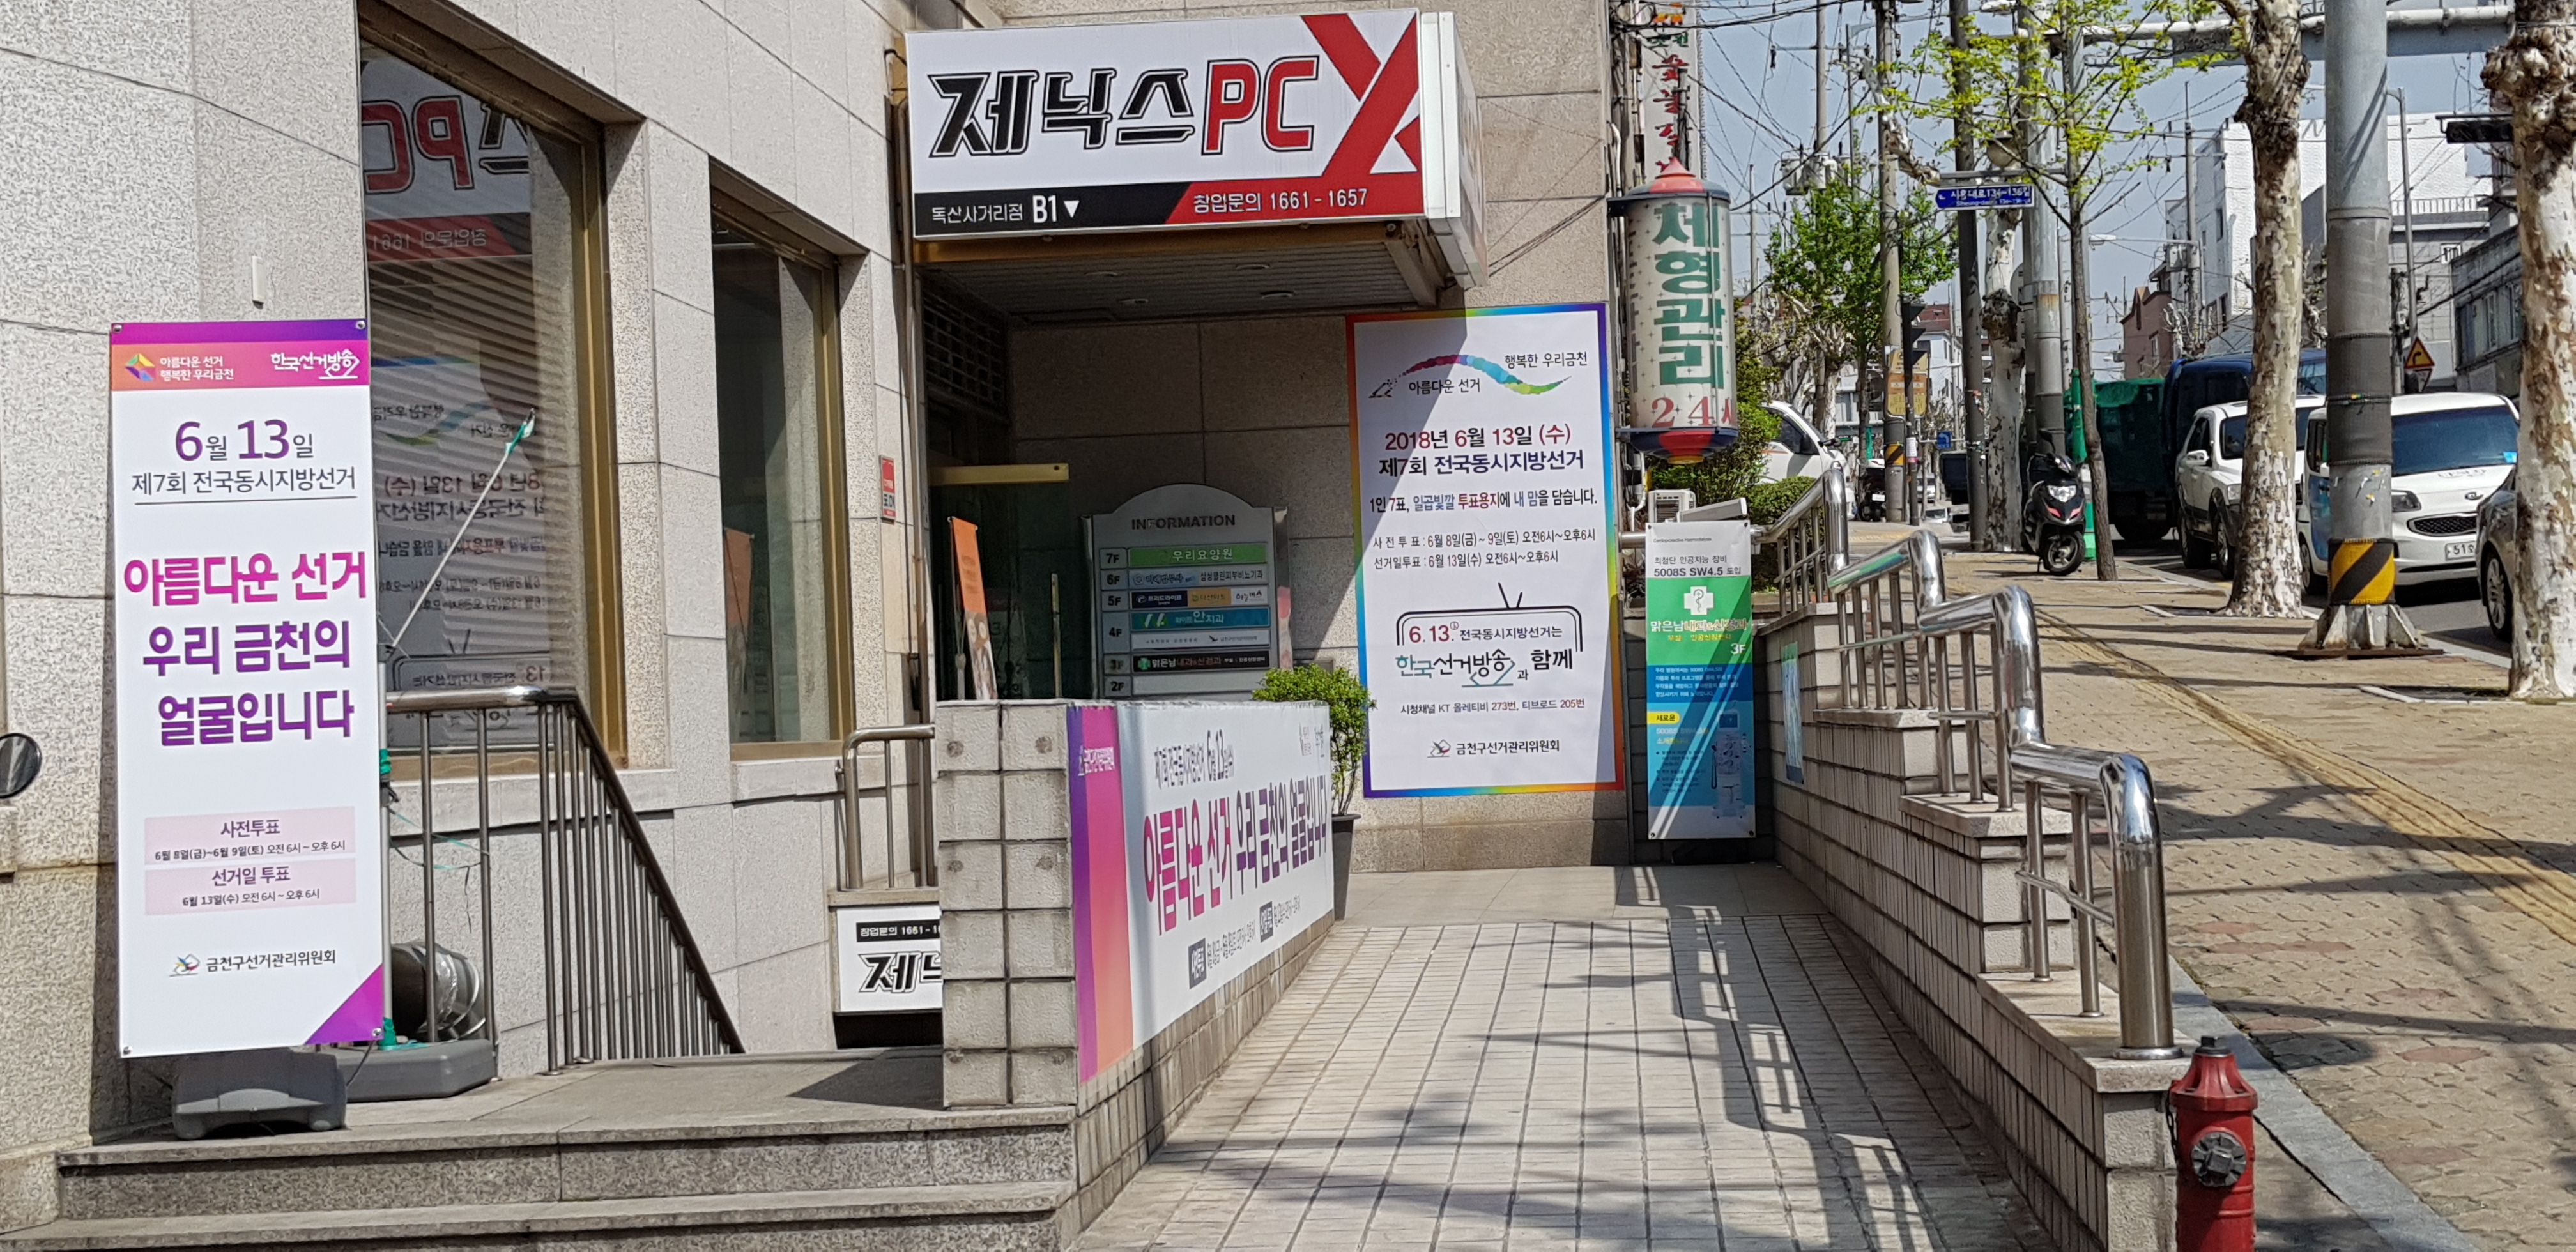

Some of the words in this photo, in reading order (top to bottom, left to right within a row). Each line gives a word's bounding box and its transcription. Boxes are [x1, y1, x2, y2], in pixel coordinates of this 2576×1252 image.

[931, 202, 1023, 225] 독산사거리점
[1032, 194, 1060, 224] B1
[1193, 191, 1262, 214] 창업문의
[1652, 203, 1725, 389] 체형관리
[160, 357, 200, 367] 아름다운
[203, 356, 223, 367] 선거
[271, 349, 360, 380] 한국선거방송
[1505, 353, 1538, 369] 행복한
[1542, 351, 1588, 367] 우리금천
[160, 369, 190, 381] 행복한
[193, 368, 234, 380] 우리금천
[1409, 379, 1455, 395] 아름다운
[1458, 378, 1481, 393] 선거
[175, 421, 228, 461] 6월
[237, 418, 314, 459] 13일
[1385, 429, 1448, 450] 2018년
[1455, 427, 1485, 447] 6월
[1492, 425, 1532, 446] 13일
[1539, 423, 1571, 445] (수)
[1379, 456, 1427, 477] 제7회
[1434, 449, 1584, 475] 전국동시지방선거
[132, 471, 186, 496] 제7회
[193, 466, 355, 494] 전국동시지방선거
[1370, 496, 1386, 512] 1인
[1390, 496, 1409, 514] 7표,
[1413, 494, 1455, 511] 일곱빛깔
[1458, 492, 1511, 509] 투표용지에
[1514, 491, 1524, 507] 내
[1528, 490, 1549, 507] 맘을
[1552, 488, 1598, 506] 담습니다.
[1131, 515, 1236, 530] INFORMATION
[1427, 534, 1443, 548] 6월
[1446, 532, 1477, 547] 8일(금)
[1488, 531, 1519, 546] 9일(토)
[1106, 553, 1119, 564] 7F
[1172, 548, 1233, 561] 우리요양원
[1374, 556, 1421, 570] 선거일투표
[1428, 554, 1444, 569] 6월
[1447, 553, 1482, 568] 13일(수)
[1680, 556, 1708, 564] 인공지능
[1712, 555, 1727, 563] 장비
[124, 553, 278, 607] 아름다운
[292, 551, 367, 600] 선거
[1107, 574, 1120, 585] 6F
[1654, 568, 1686, 577] 5008S
[1689, 567, 1723, 576] SW4.5
[1726, 567, 1741, 575] 도입
[1108, 595, 1121, 606] 5F
[1109, 627, 1122, 637] 4F
[1459, 626, 1563, 641] 전국동시지방선거는
[143, 625, 220, 676] 우리
[234, 620, 349, 673] 금천의
[1730, 643, 1746, 655] 3F
[1395, 648, 1515, 688] 한국선거방송
[1517, 669, 1529, 681] 과
[1531, 648, 1573, 671] 함께
[1110, 682, 1124, 692] 2F
[1400, 703, 1436, 715] 시청채널
[1438, 704, 1450, 714] KT
[1453, 701, 1489, 714] 올레티비
[1522, 699, 1557, 710] 티브로드
[1560, 698, 1585, 710] 205번
[158, 689, 355, 747] 얼굴입니다
[1456, 739, 1560, 756] 금천구선거관리위원회
[220, 819, 280, 839] 사전투표
[155, 850, 171, 861] 6월
[232, 845, 264, 857] 9일(토)
[266, 844, 284, 855] 오전
[287, 843, 302, 854] 6시
[312, 841, 329, 851] 오후
[331, 840, 346, 851] 6시
[1144, 799, 1204, 936] 아름다운
[1208, 798, 1233, 908] 선거
[1236, 790, 1257, 895] 우리
[1259, 782, 1289, 883] 금천의
[1289, 774, 1327, 869] 얼굴입니다
[212, 867, 256, 887] 선거일
[260, 866, 291, 884] 투표
[183, 896, 198, 907] 6월
[201, 893, 240, 906] 13일(수)
[241, 892, 259, 904] 오전
[261, 891, 276, 902] 6시
[286, 890, 303, 900] 오후
[305, 889, 320, 899] 6시
[861, 926, 897, 937] 창업문의
[206, 949, 337, 972] 금천구선거관리위원회
